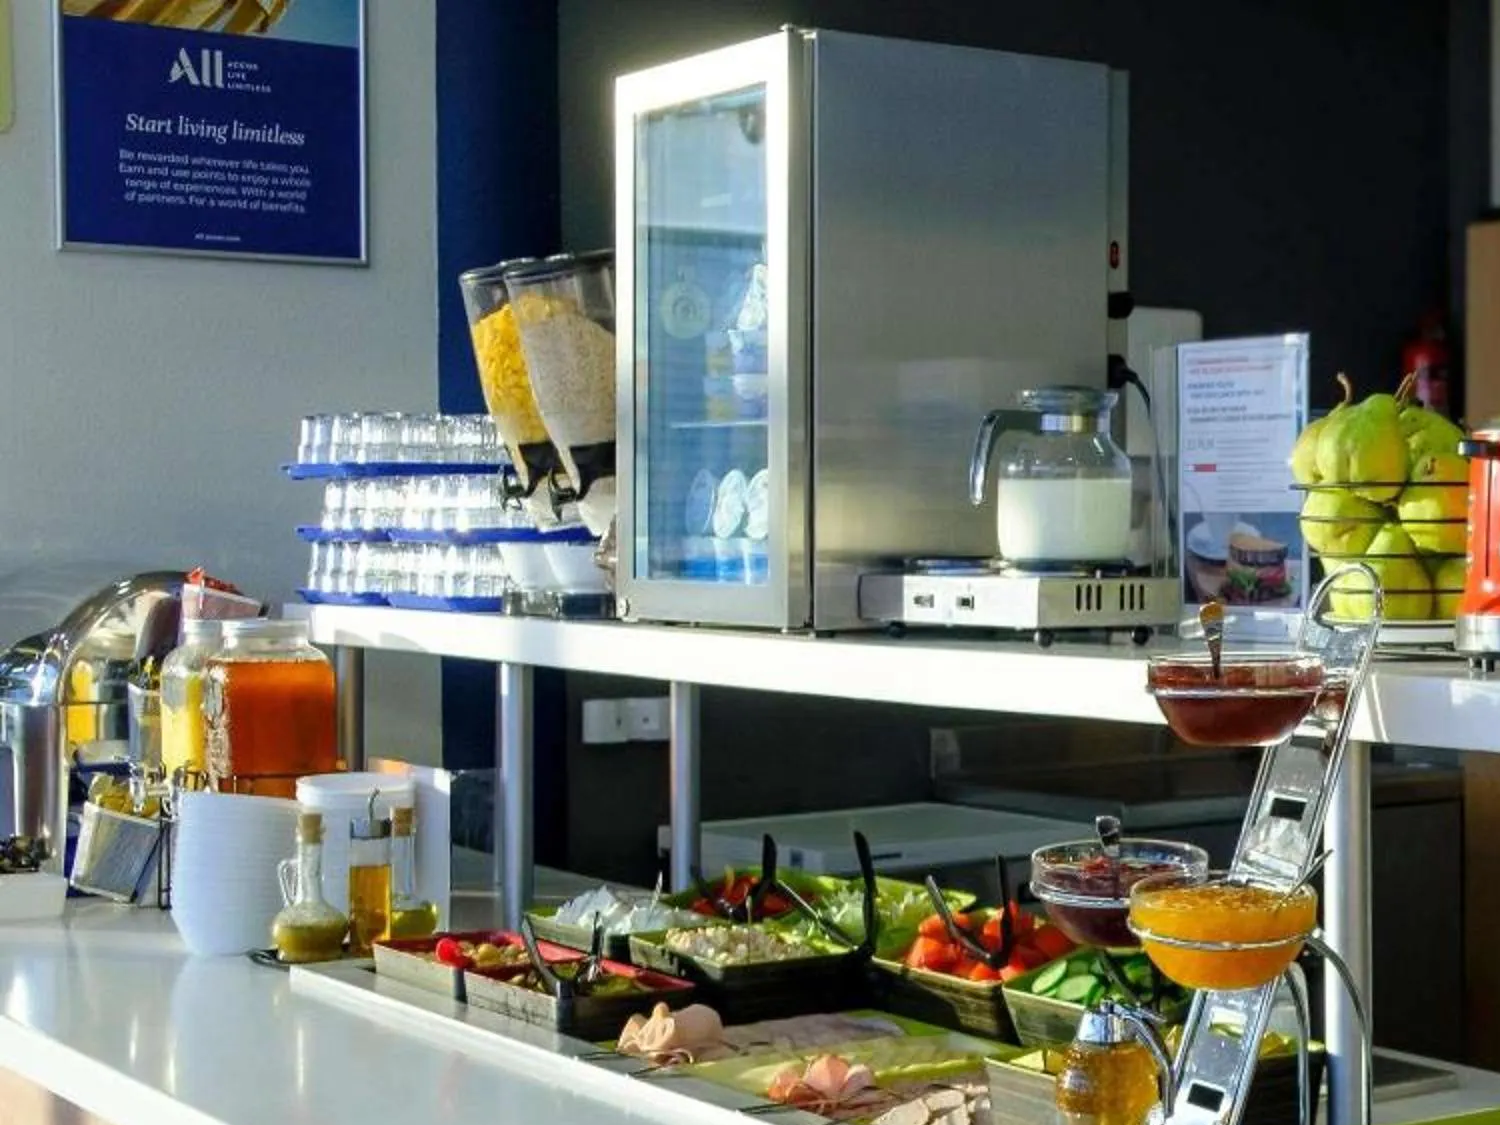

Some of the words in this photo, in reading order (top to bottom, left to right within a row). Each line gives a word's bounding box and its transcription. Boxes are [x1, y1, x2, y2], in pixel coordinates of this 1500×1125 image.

[167, 47, 225, 88] All
[125, 113, 173, 135] Start
[177, 115, 229, 145] living
[231, 120, 306, 146] limitless
[137, 151, 190, 164] rewarded
[242, 159, 259, 170] life
[119, 162, 145, 174] Earn
[147, 165, 169, 177] and
[170, 169, 191, 178] use
[192, 170, 227, 182] points
[228, 172, 240, 182] to
[125, 178, 158, 191] range
[160, 180, 172, 190] of
[124, 190, 137, 202] of
[249, 199, 261, 210] of
